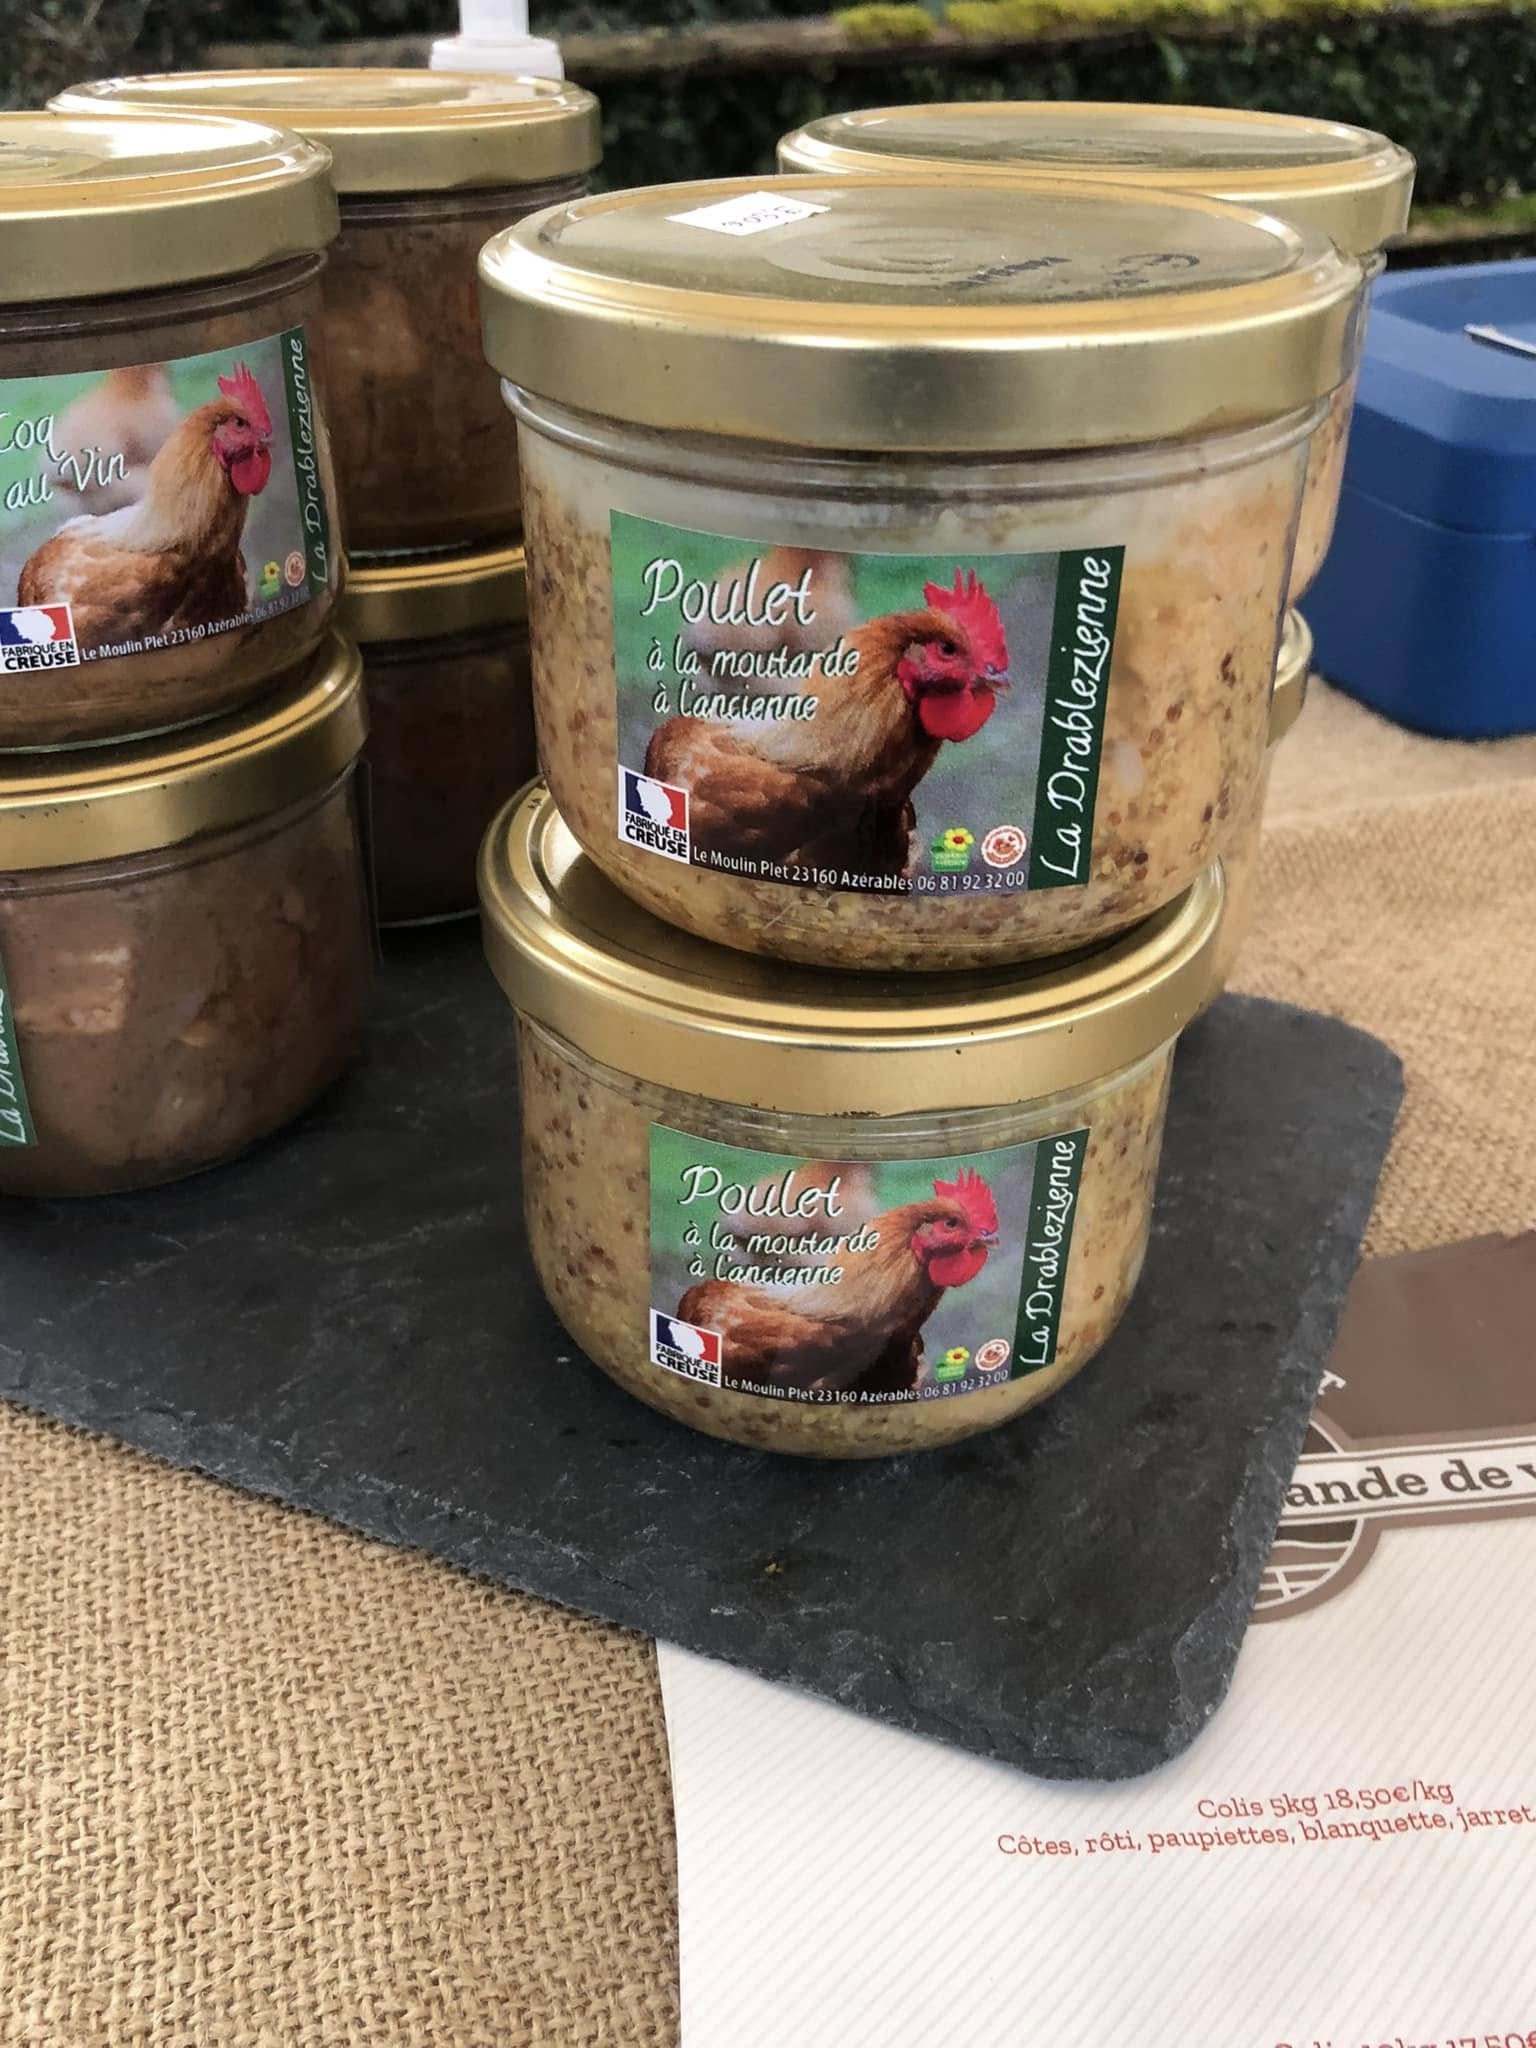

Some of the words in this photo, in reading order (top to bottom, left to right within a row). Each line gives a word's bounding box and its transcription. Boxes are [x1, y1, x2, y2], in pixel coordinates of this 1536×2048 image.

[290, 338, 322, 533] Drablezienne
[6, 473, 54, 510] au
[60, 448, 130, 491] Vin
[312, 543, 328, 583] La
[641, 558, 817, 626] Poulet
[5, 652, 77, 671] CREUSE
[60, 641, 74, 653] EN
[82, 647, 97, 661] Le
[100, 639, 143, 658] Moulin
[171, 624, 206, 645] 23160
[648, 639, 666, 671] à
[675, 635, 702, 675] la
[711, 637, 861, 679] moutarde
[654, 683, 671, 714] à
[680, 679, 819, 721] l'ancienne
[1048, 555, 1112, 813] Drablezienne
[626, 825, 688, 859] CREUSE
[673, 830, 687, 842] EN
[1040, 823, 1082, 878] La
[693, 846, 708, 863] Le
[710, 850, 757, 874] Moulin
[761, 862, 788, 880] Plet
[792, 865, 837, 885] 23160
[841, 870, 914, 891] Azérables
[917, 875, 936, 891] 06
[940, 875, 957, 890] 81
[963, 874, 980, 890] 92
[985, 873, 1002, 888] 32
[1006, 871, 1025, 887] 00
[679, 1165, 844, 1218] Poulet
[685, 1222, 702, 1246] à
[712, 1222, 737, 1251] la
[747, 1224, 881, 1255] moutarde
[1025, 1140, 1076, 1320] Drablezienne
[689, 1254, 706, 1278] à
[716, 1254, 844, 1285] l'ancienne
[1019, 1325, 1050, 1364] La
[656, 1353, 719, 1384] CREUSE
[705, 1362, 719, 1374] EN
[724, 1375, 739, 1389] Le
[741, 1380, 785, 1398] Moulin
[788, 1387, 814, 1401] Plet
[817, 1390, 857, 1402] 23160
[860, 1388, 921, 1403] Azérables
[924, 1385, 940, 1398] 06
[942, 1382, 956, 1396] 81
[960, 1379, 974, 1393] 92
[977, 1374, 991, 1388] 32
[994, 1369, 1009, 1383] 00
[1283, 1466, 1429, 1507] ande
[1440, 1459, 1513, 1493] de
[1198, 1798, 1264, 1820] Colis
[1271, 1793, 1318, 1817] 5kg
[1324, 1780, 1455, 1811] 18,50€/kg
[998, 1834, 1079, 1856] Côtes,
[1086, 1829, 1142, 1854] rôti,
[1148, 1825, 1296, 1853] paupiettes,
[1300, 1810, 1455, 1842] blanquette,
[1456, 1805, 1536, 1832] jarret
